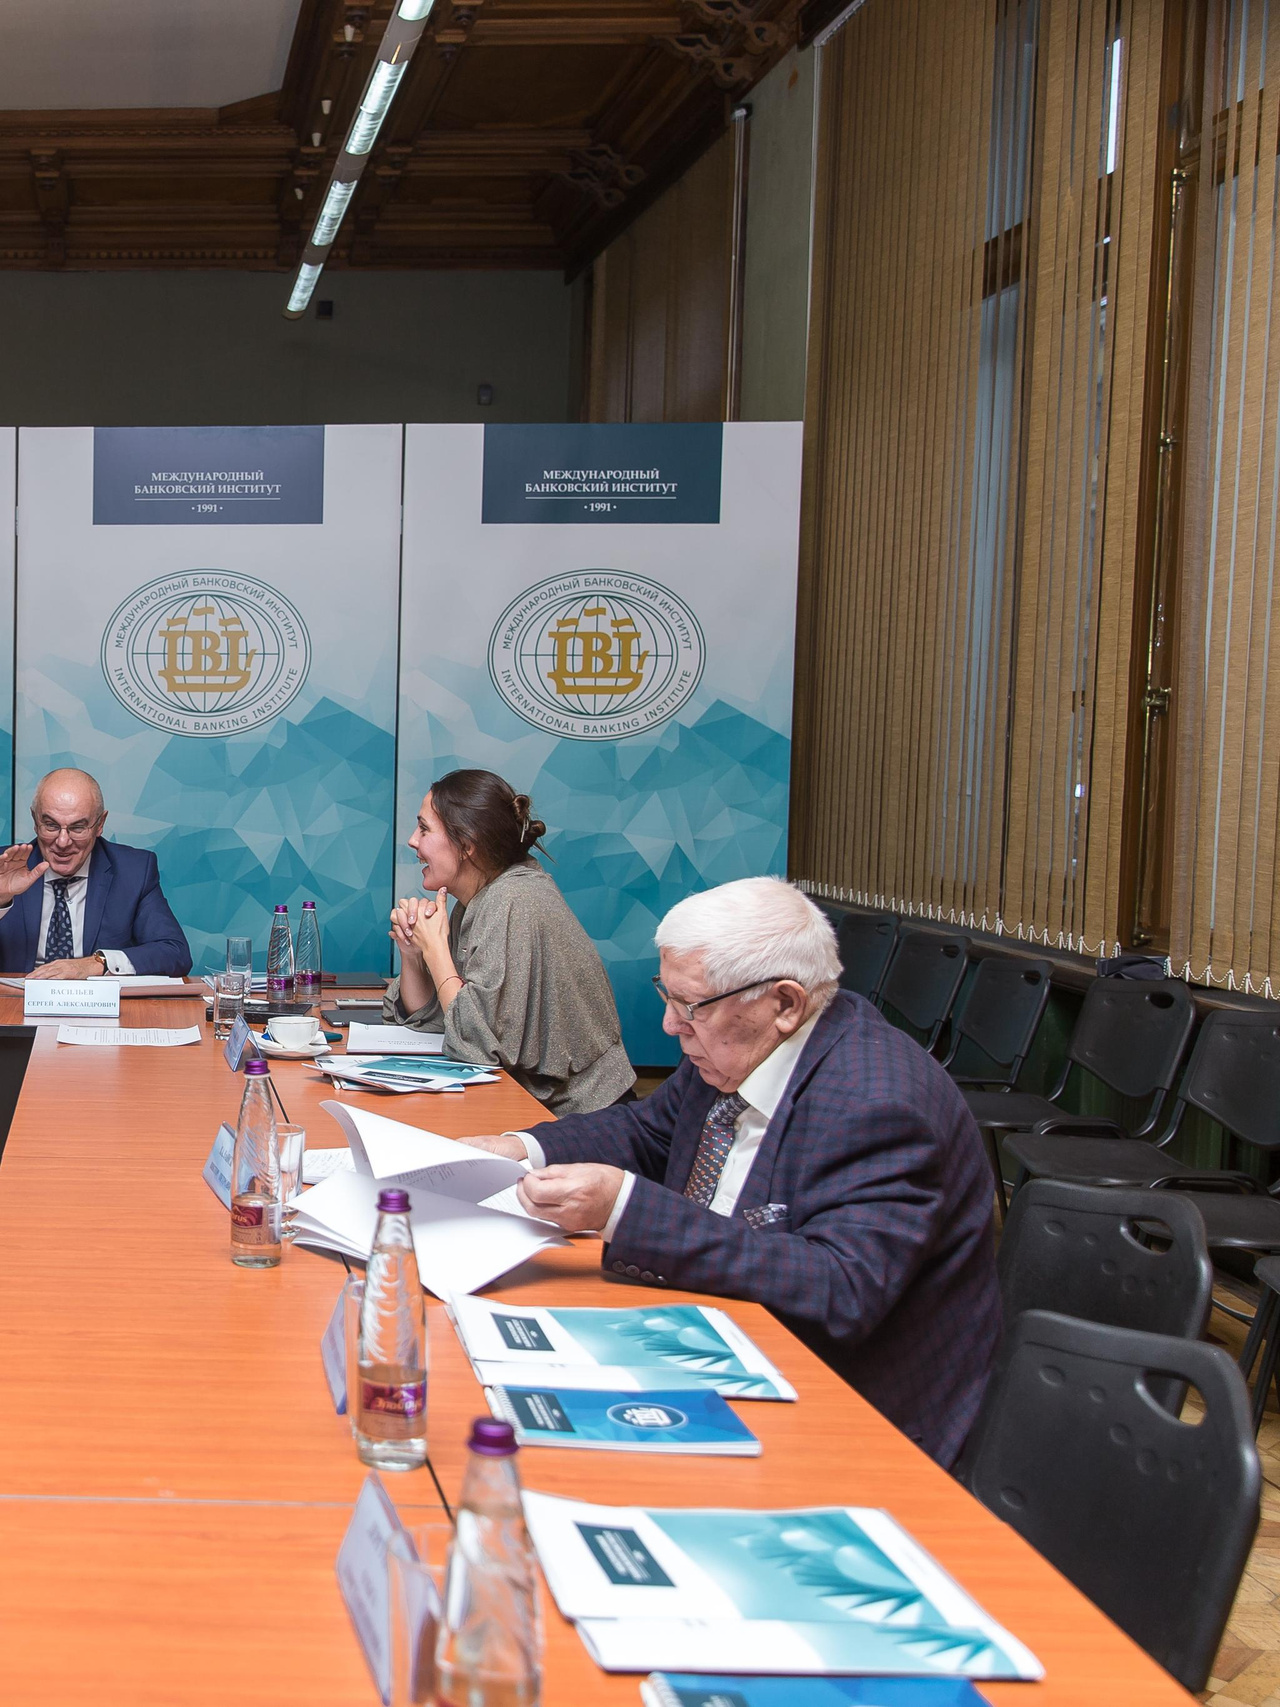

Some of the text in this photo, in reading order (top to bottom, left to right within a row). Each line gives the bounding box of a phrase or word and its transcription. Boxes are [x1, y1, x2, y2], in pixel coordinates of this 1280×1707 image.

[151, 470, 264, 483] МЕЖДУНАРОДНЫЙ
[543, 468, 660, 481] МЕЖДУНАРОДНЫЙ
[134, 483, 281, 495] БАНКОВСКИЙ ИНСТИТУТ
[525, 481, 678, 494] БАНКОВСКИЙ ИНСТИТУТ
[115, 577, 298, 649] МЕЖДУНАРОДНЫЙ БАНКОВСКИЙ ИНСТИТУТ
[503, 577, 692, 650] МЕЖДУНАРОДНЫЙ БАНКОВСКИЙ ИНСТИТУТ
[114, 667, 298, 731] INTERNATIONAL BANKING INSTITUTE
[501, 669, 692, 734] INTERNATIONAL BANKING INSTITUTE
[50, 988, 94, 996] ВАСИЛЬЕВ
